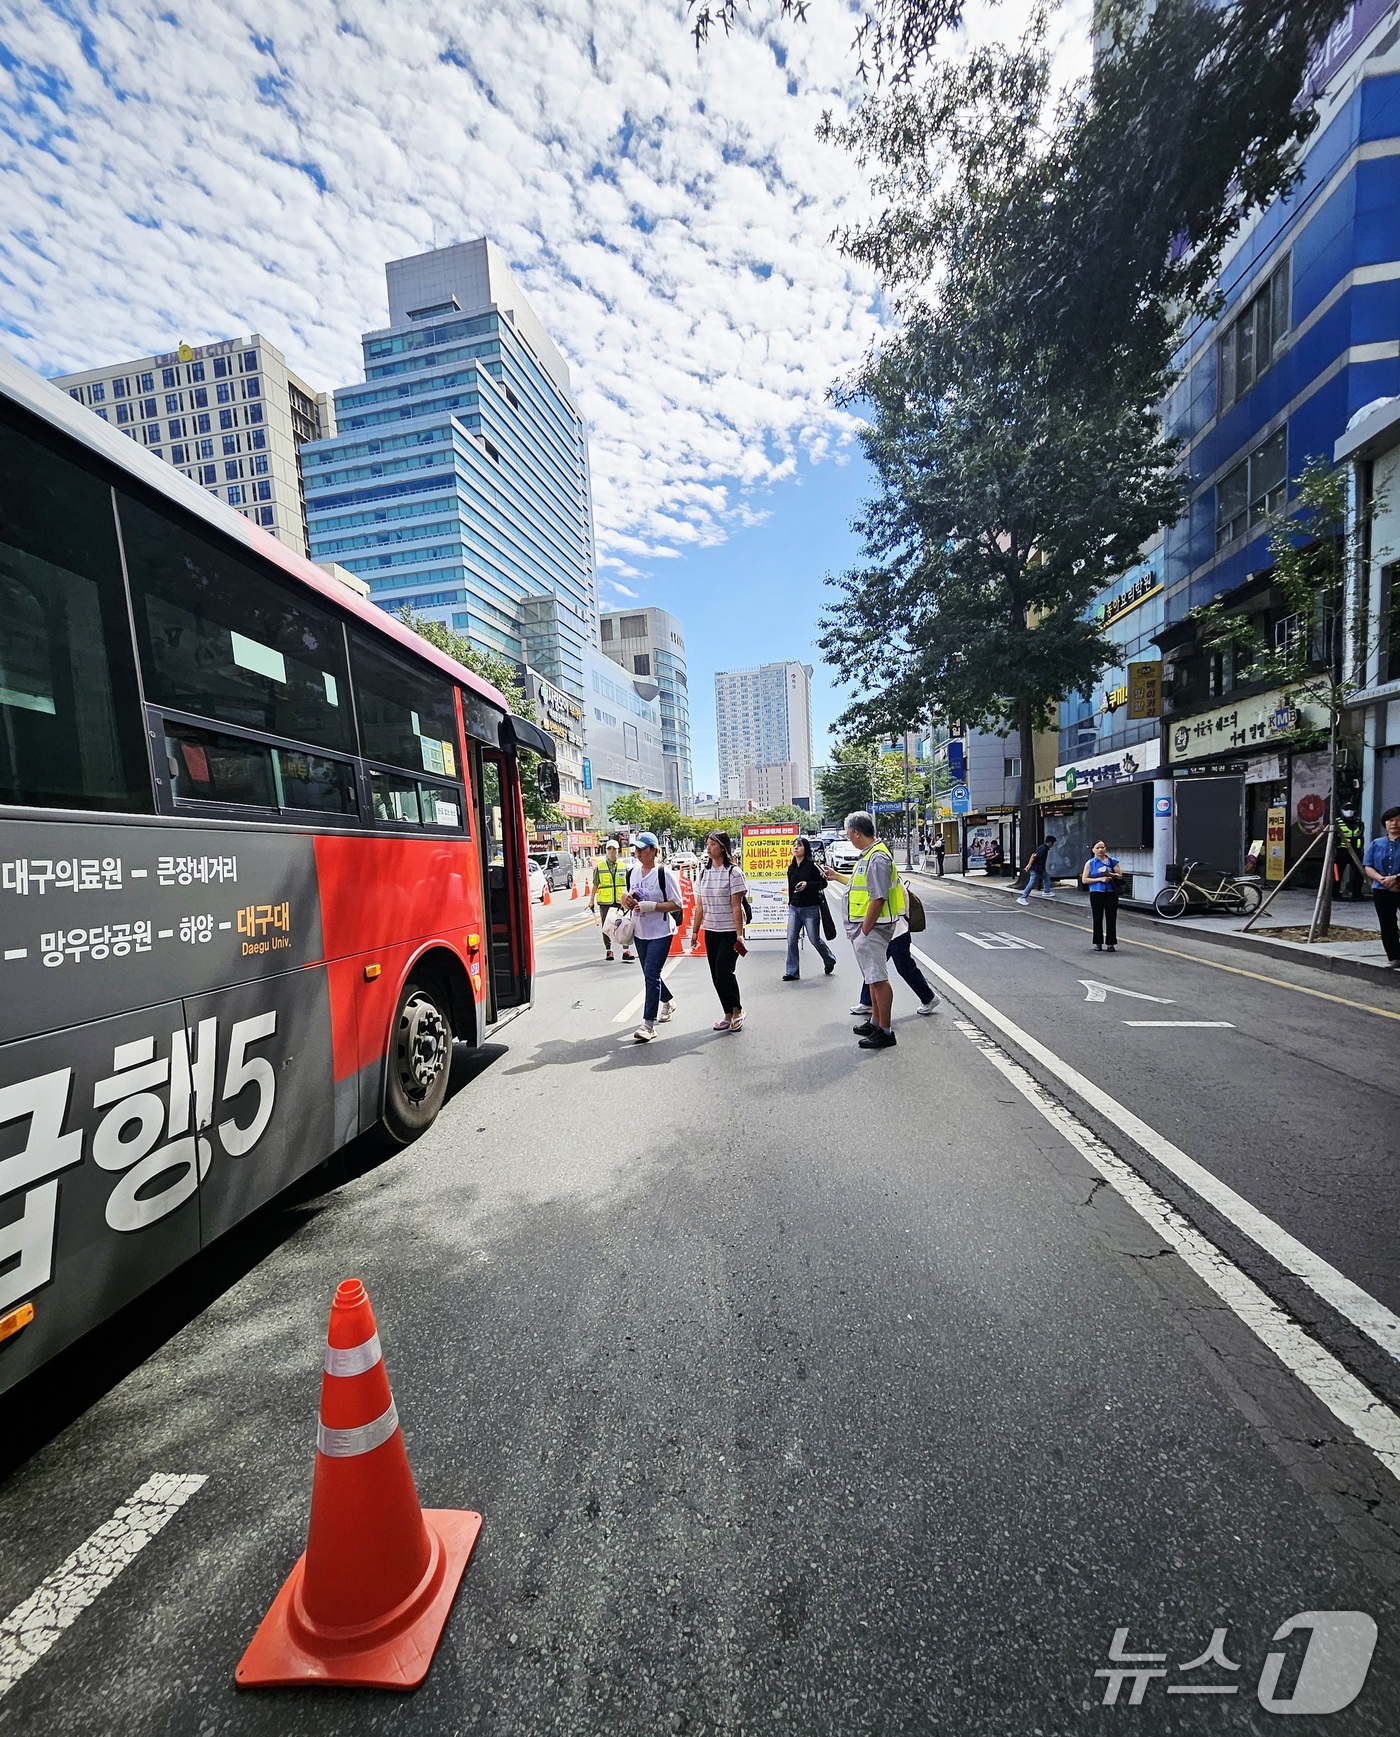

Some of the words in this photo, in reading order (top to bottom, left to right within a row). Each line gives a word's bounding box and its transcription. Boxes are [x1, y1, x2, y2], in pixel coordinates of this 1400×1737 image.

[154, 343, 203, 369] LEMON
[206, 339, 235, 358] CITY
[1267, 708, 1297, 730] KMB
[746, 847, 778, 858] 시내버스
[2, 857, 123, 895] 대구의료원
[157, 856, 237, 886] 큰장네거리
[750, 859, 774, 870] 승하차
[40, 920, 152, 968] 망우당공원
[179, 913, 213, 945] 하양
[237, 901, 290, 938] 대구대
[242, 942, 270, 956] Daegu
[271, 937, 292, 951] Univ.
